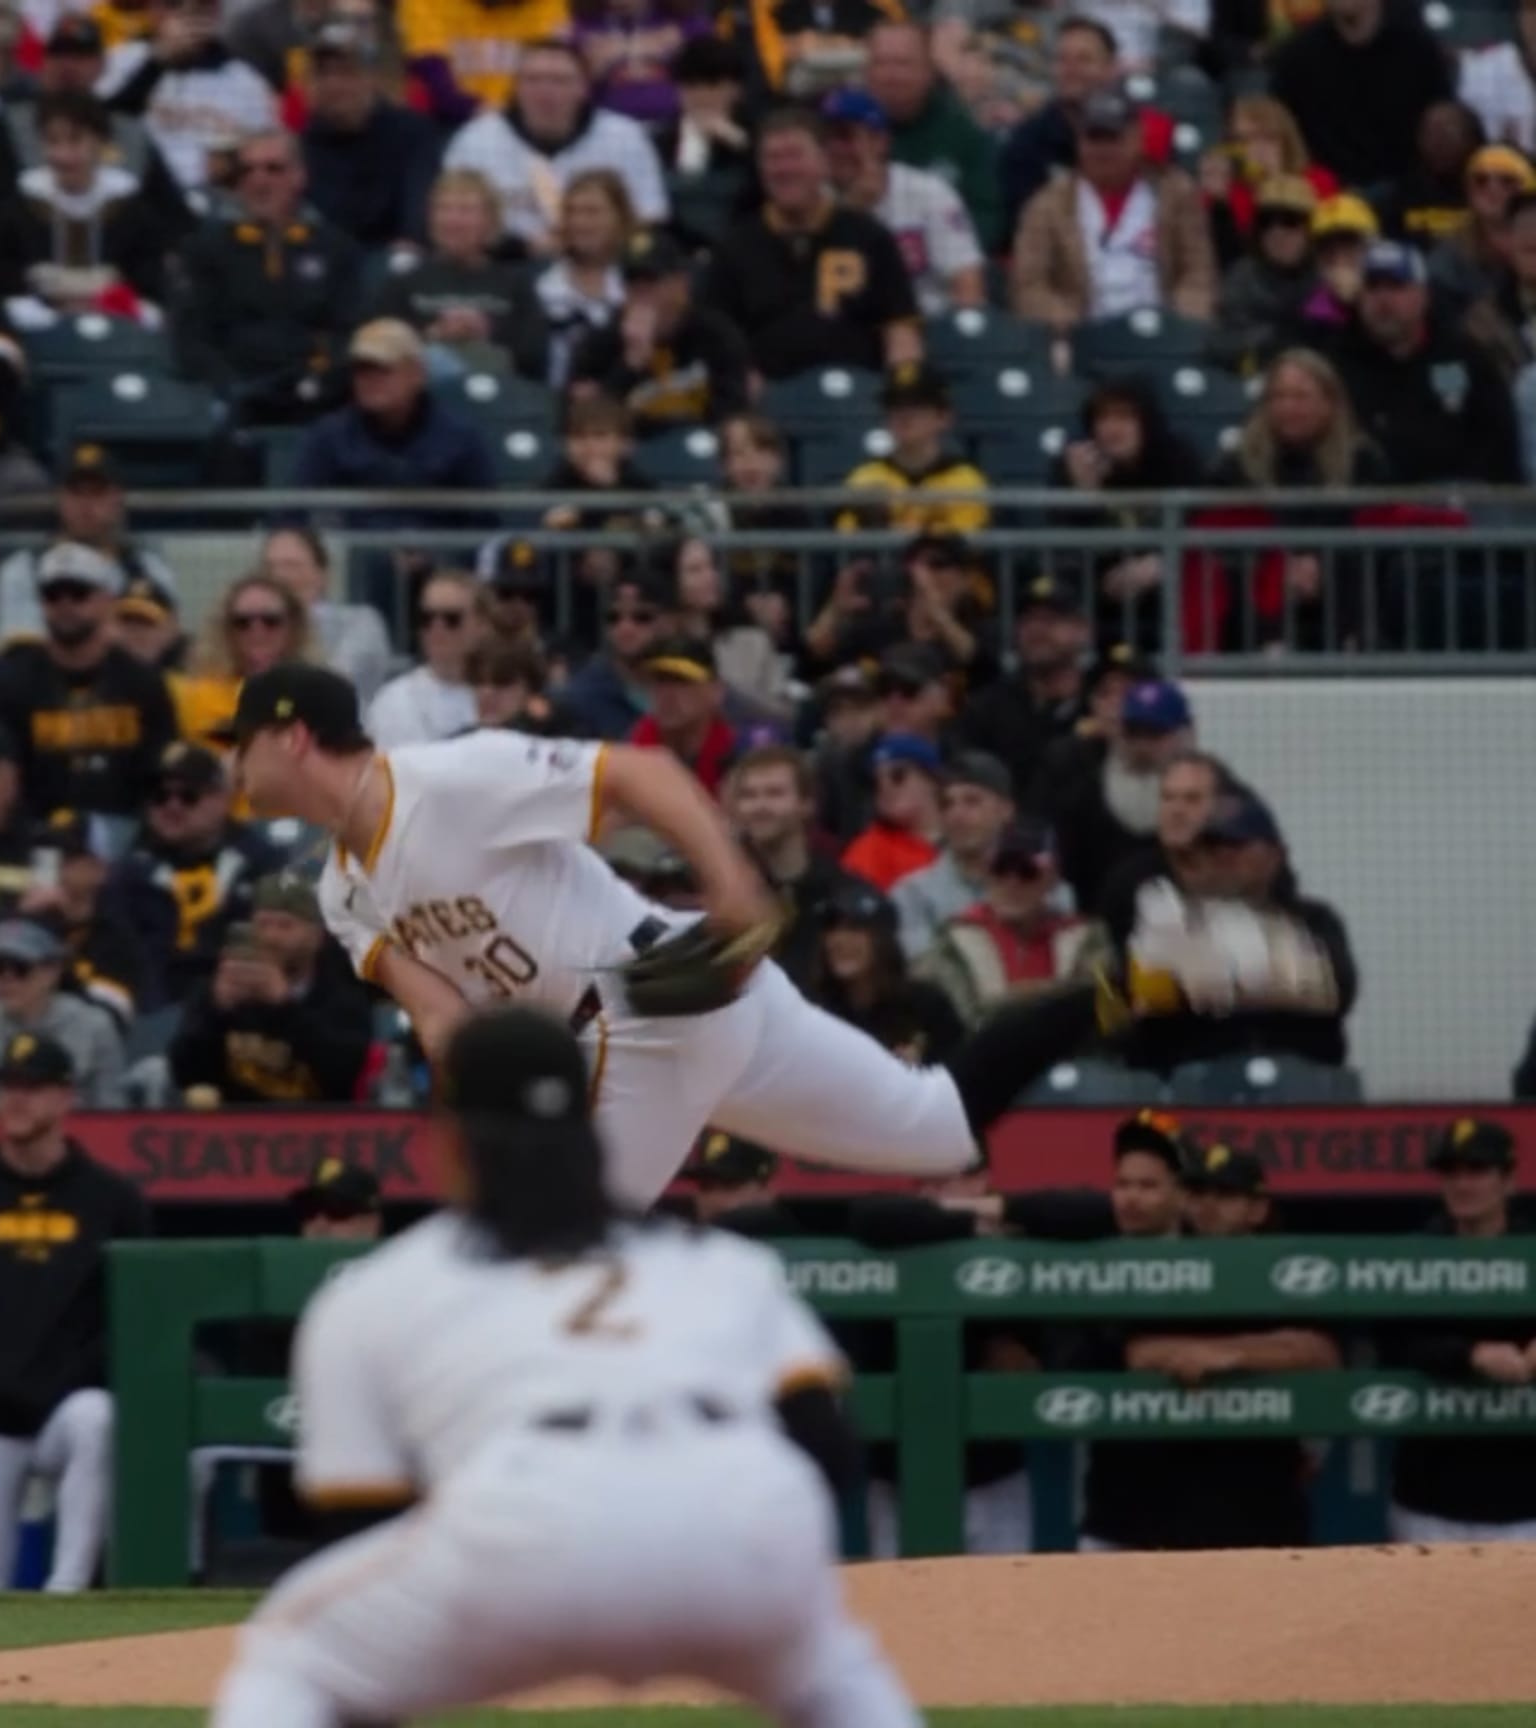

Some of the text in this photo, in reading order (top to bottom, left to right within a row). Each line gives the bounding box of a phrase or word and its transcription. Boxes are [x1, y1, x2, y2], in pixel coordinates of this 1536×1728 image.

[817, 249, 865, 317] P
[176, 867, 221, 949] P
[131, 1126, 416, 1184] SEATGEEK
[782, 1260, 898, 1294] UNDAI
[1030, 1260, 1214, 1292] HYUNDAI
[1345, 1259, 1528, 1292] HYUNDAI
[1110, 1389, 1293, 1423] HYUNDAI
[1424, 1387, 1536, 1421] HYUN
